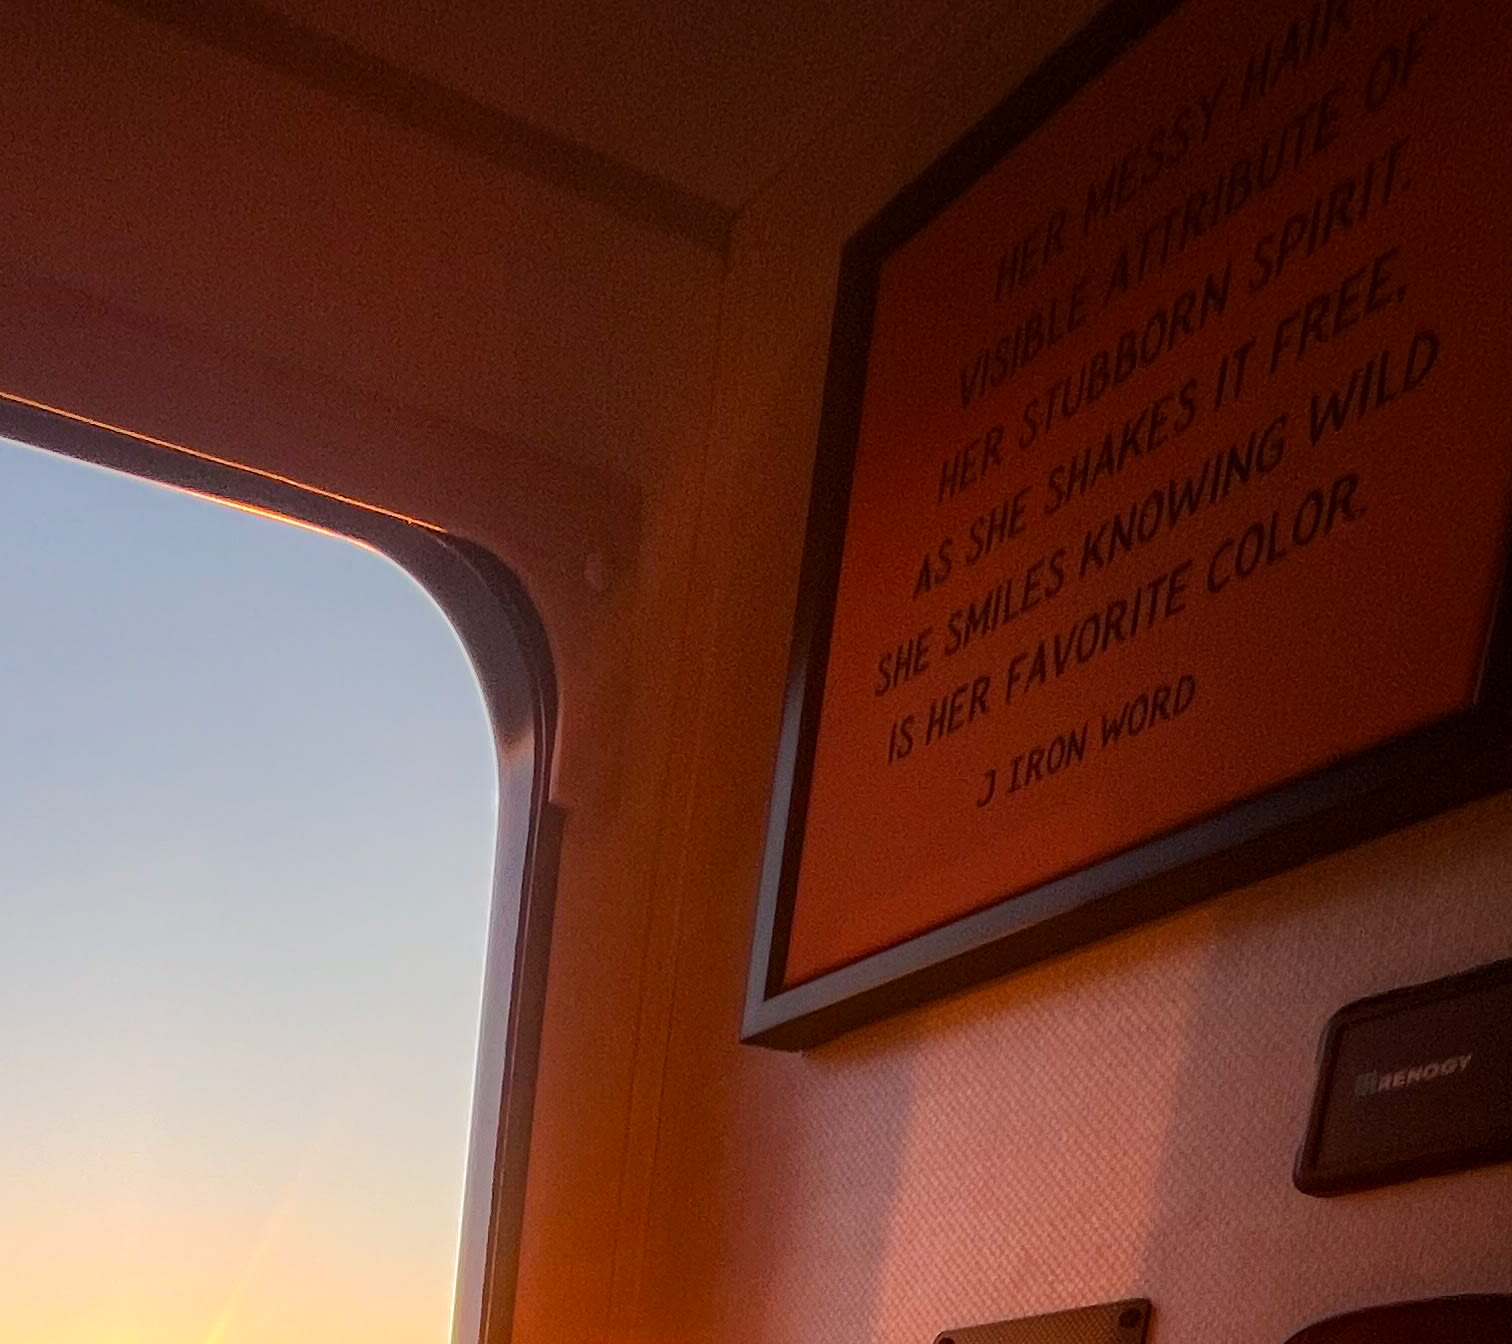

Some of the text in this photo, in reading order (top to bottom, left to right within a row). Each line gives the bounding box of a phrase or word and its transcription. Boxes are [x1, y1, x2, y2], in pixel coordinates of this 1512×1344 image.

[938, 135, 1412, 504] HER STUBBORN SPIRIT.
[959, 15, 1434, 408] VISIBLE ATTRIBUTE OF
[995, 209, 1066, 301] HER
[1085, 79, 1226, 231] MESSY
[874, 329, 1440, 697] SHE SMILES KNOWING WILD
[913, 538, 953, 600] AS
[966, 487, 1031, 565] SHE
[1044, 379, 1198, 514] SHAKES
[1214, 338, 1256, 410] IT
[888, 473, 1368, 765] IS HER FAVORITE COLOR.
[977, 674, 1197, 809] J IRON WORD
[1376, 1053, 1472, 1095] RENOGY
